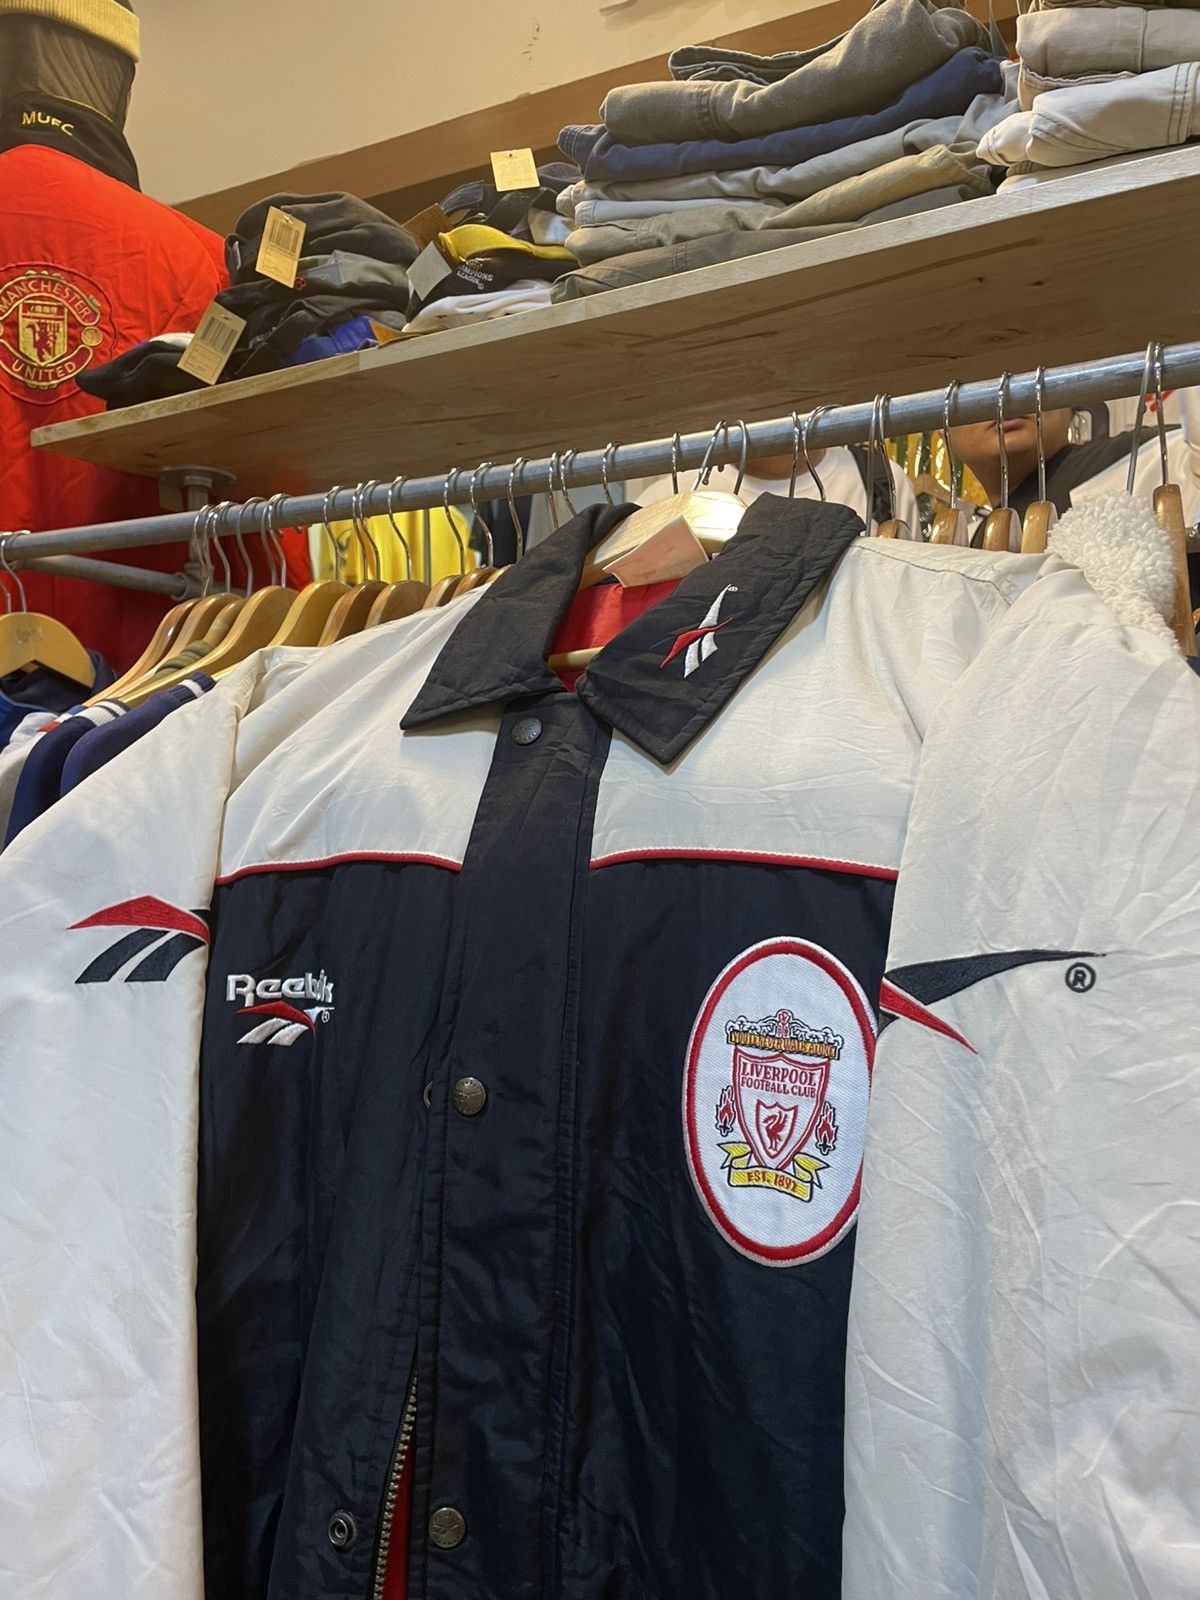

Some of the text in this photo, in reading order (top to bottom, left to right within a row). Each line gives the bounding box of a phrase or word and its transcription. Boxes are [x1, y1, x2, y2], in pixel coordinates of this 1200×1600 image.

[21, 111, 75, 136] MUFC
[0, 280, 91, 320] MANCHESTER
[11, 359, 76, 381] UNITED
[741, 1062, 817, 1087] LIVERPOOL
[741, 1077, 816, 1098] FOOTBALL CLUB
